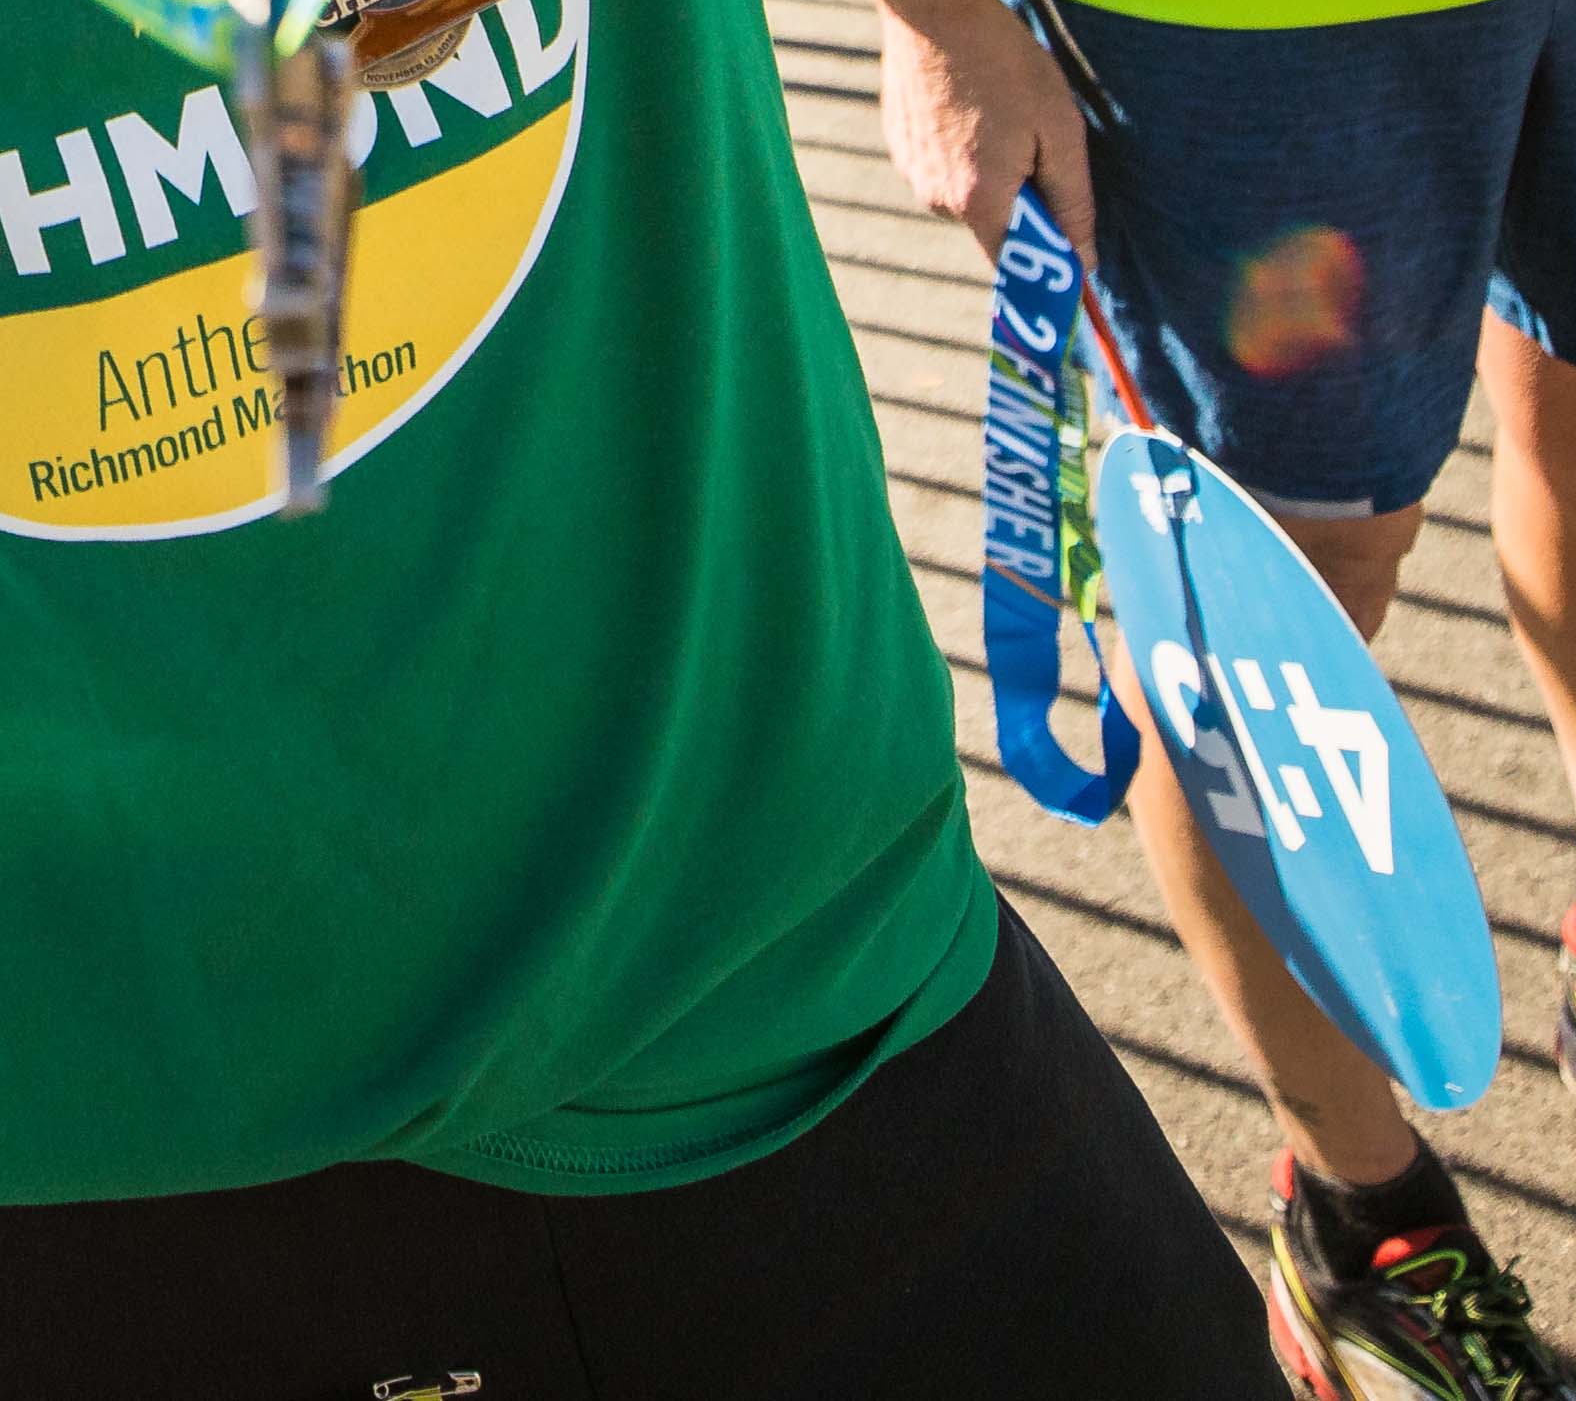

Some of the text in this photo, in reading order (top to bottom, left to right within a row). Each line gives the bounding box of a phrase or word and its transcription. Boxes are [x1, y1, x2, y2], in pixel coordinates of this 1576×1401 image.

[29, 341, 417, 502] Richmond Mathon
[98, 313, 273, 432] Anthe
[985, 348, 1056, 581] FINISHER
